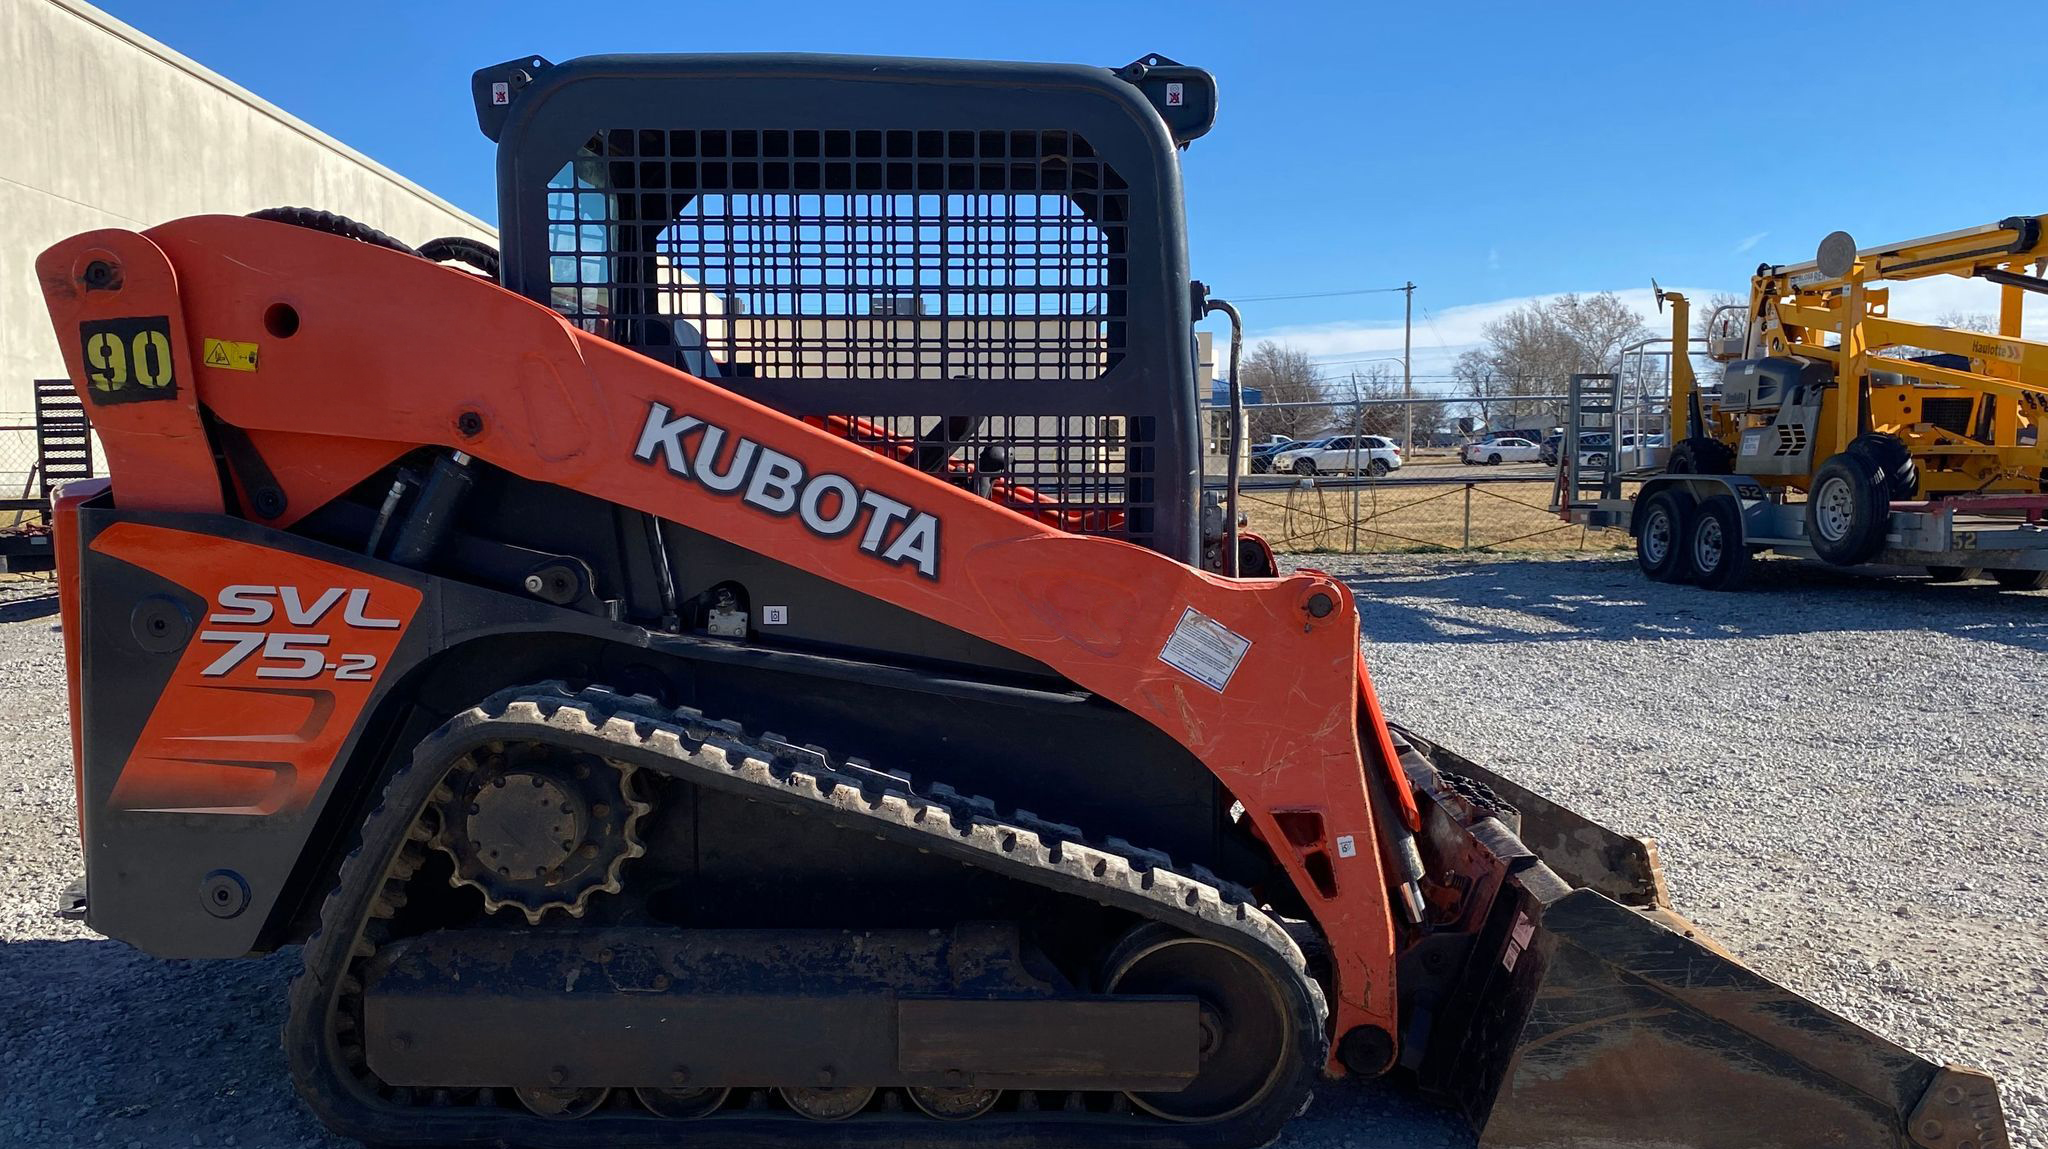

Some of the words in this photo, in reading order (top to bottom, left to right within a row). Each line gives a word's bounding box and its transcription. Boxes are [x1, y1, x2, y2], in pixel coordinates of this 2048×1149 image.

[87, 330, 173, 392] 90
[1972, 340, 2006, 357] Haulotte
[633, 401, 939, 579] KUBOTA
[1738, 485, 1762, 498] 52
[1952, 531, 1977, 550] 52
[209, 584, 401, 628] SVL
[200, 630, 378, 681] 75-2
